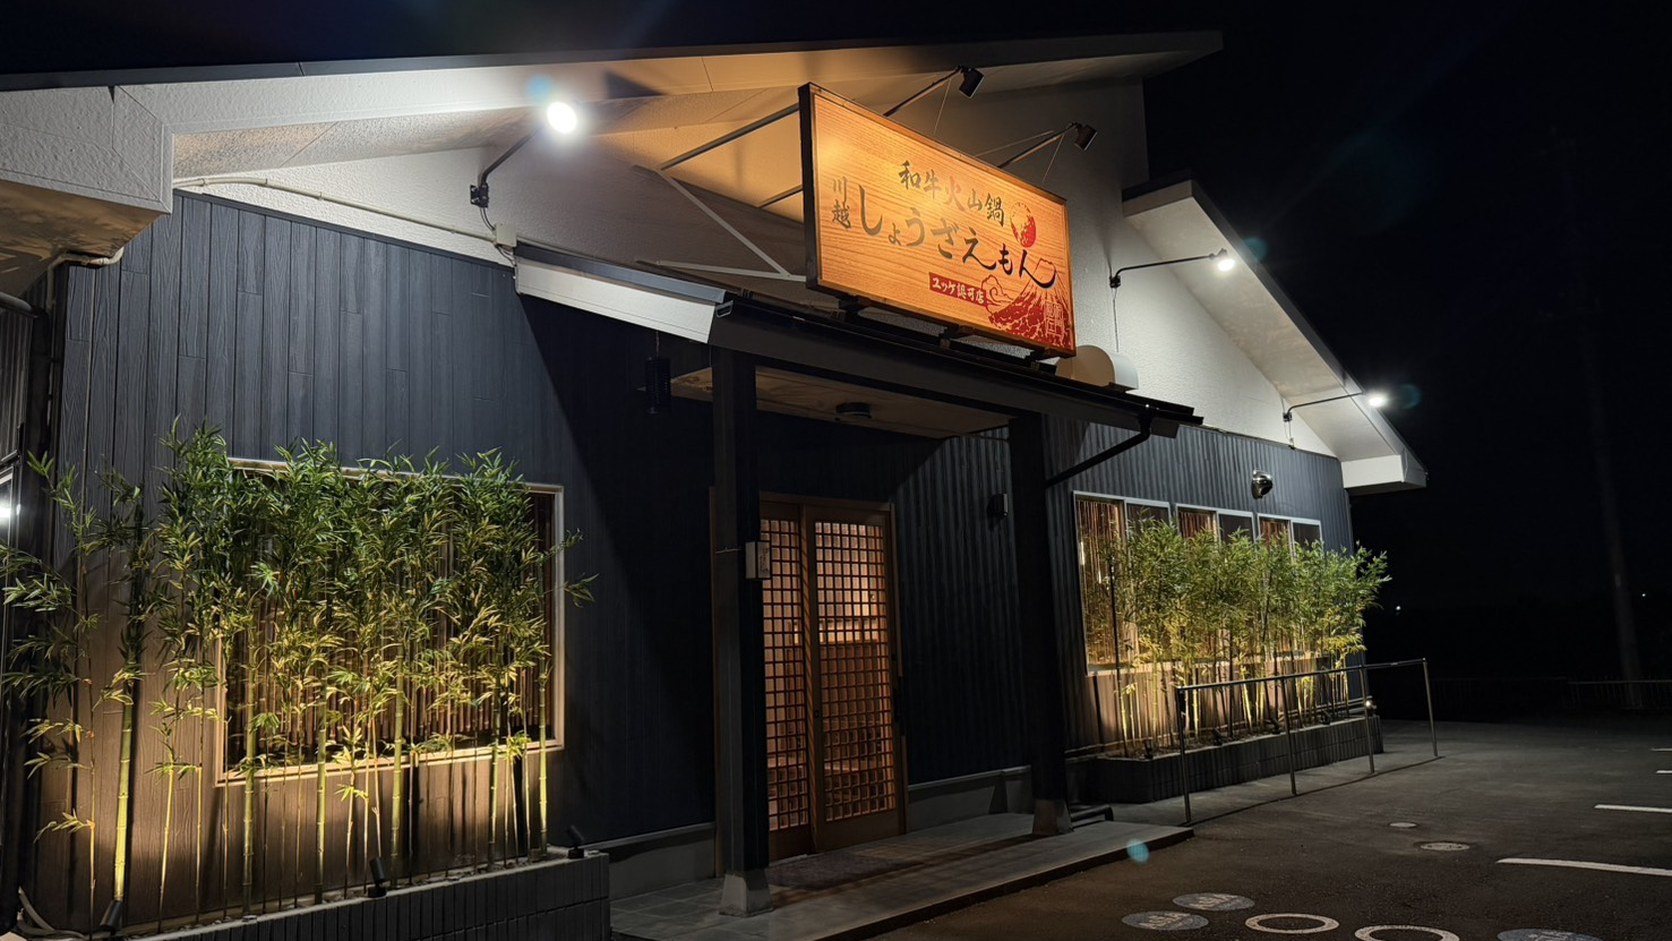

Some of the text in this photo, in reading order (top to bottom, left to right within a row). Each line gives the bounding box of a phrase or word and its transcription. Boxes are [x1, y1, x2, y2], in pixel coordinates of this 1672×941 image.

[832, 176, 851, 229] 川越
[898, 160, 1004, 227] 和牛火山鍋
[859, 184, 1056, 289] しょうざえもん
